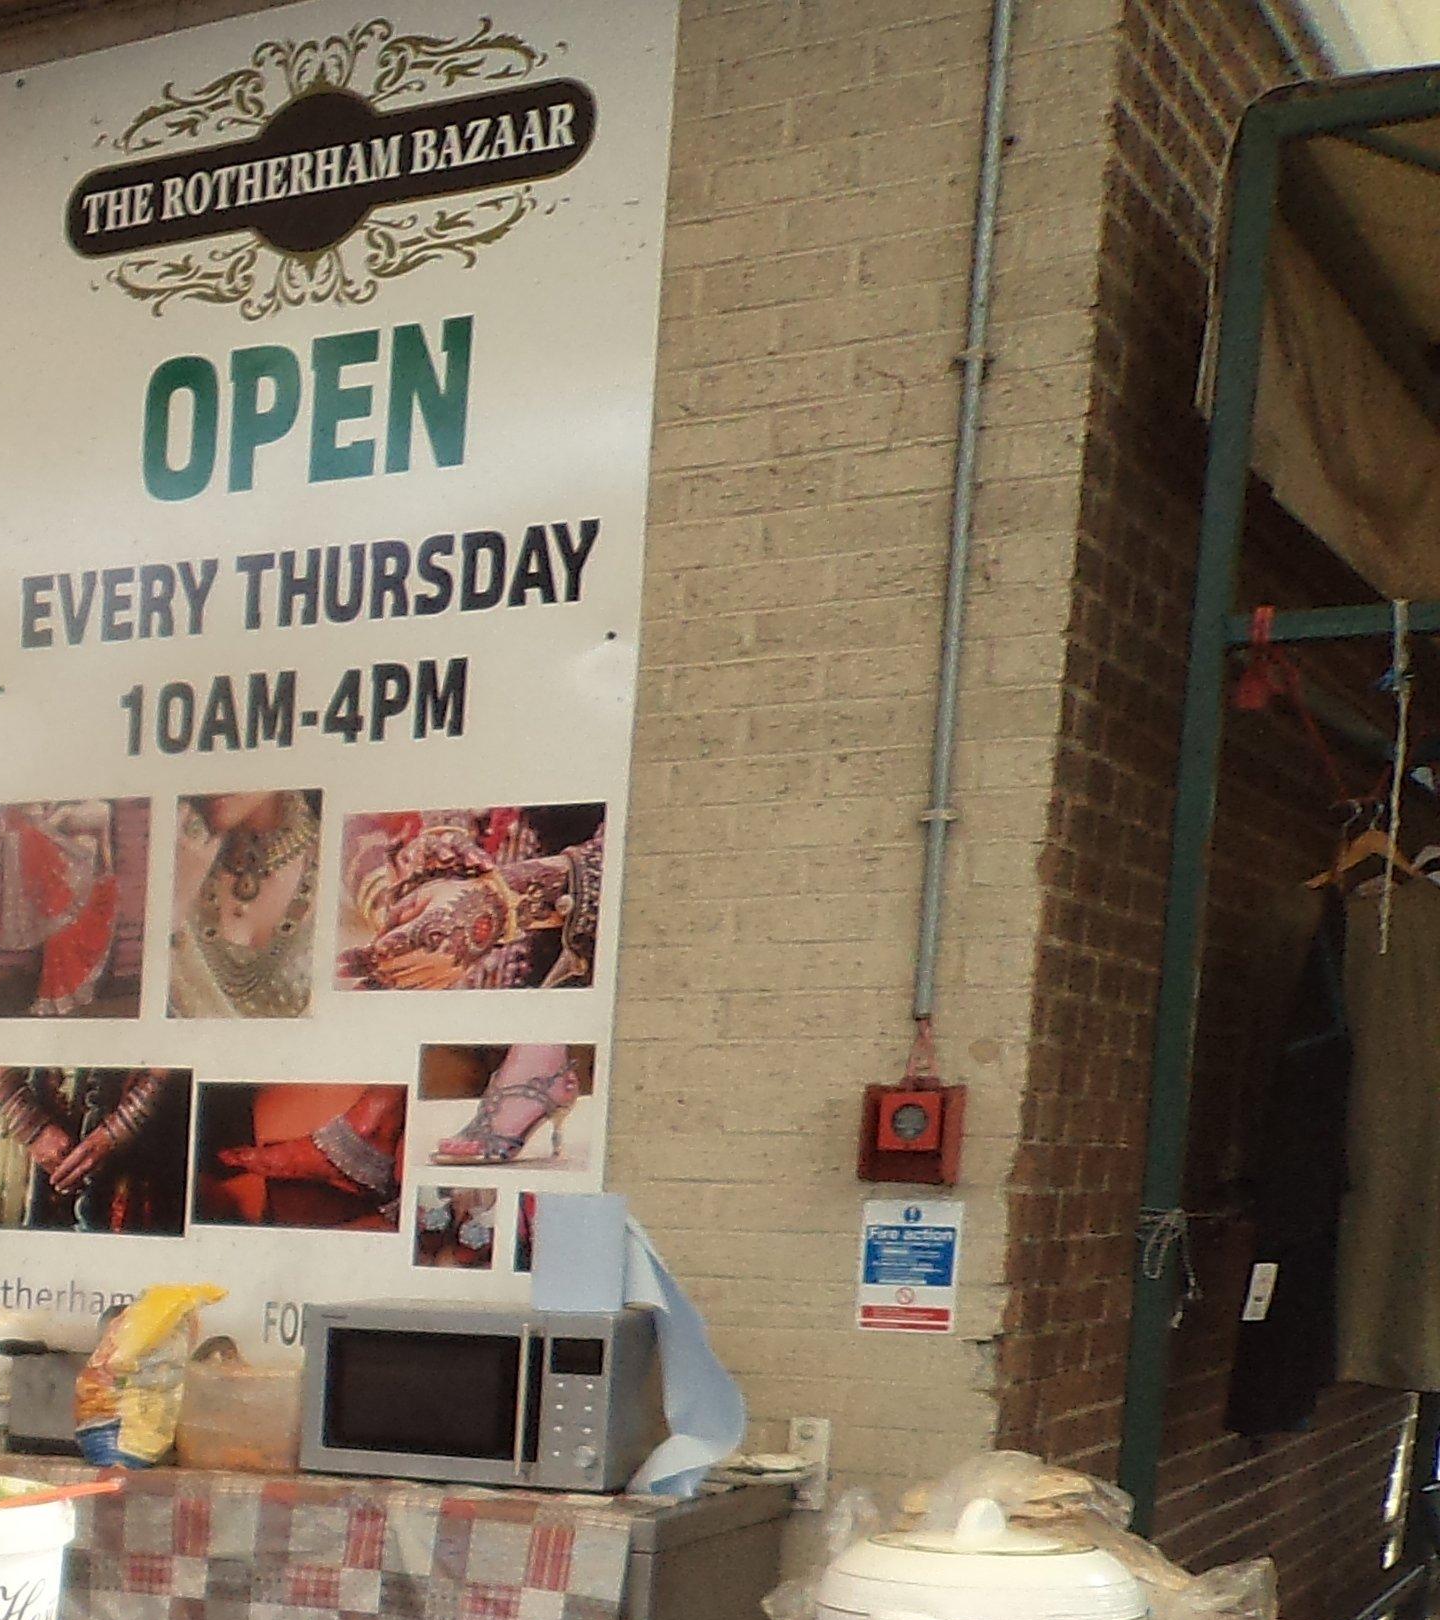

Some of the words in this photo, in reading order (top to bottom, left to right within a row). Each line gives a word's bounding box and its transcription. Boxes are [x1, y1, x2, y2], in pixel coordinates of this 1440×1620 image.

[82, 182, 154, 237] THE
[161, 134, 403, 222] ROTHERHAM
[409, 102, 577, 177] BAZAAR
[141, 314, 475, 502] OPEN
[21, 557, 218, 649] EVERY
[236, 518, 601, 630] THURSDAY
[121, 656, 469, 756] 10AM-4PM
[263, 1301, 304, 1346] FO
